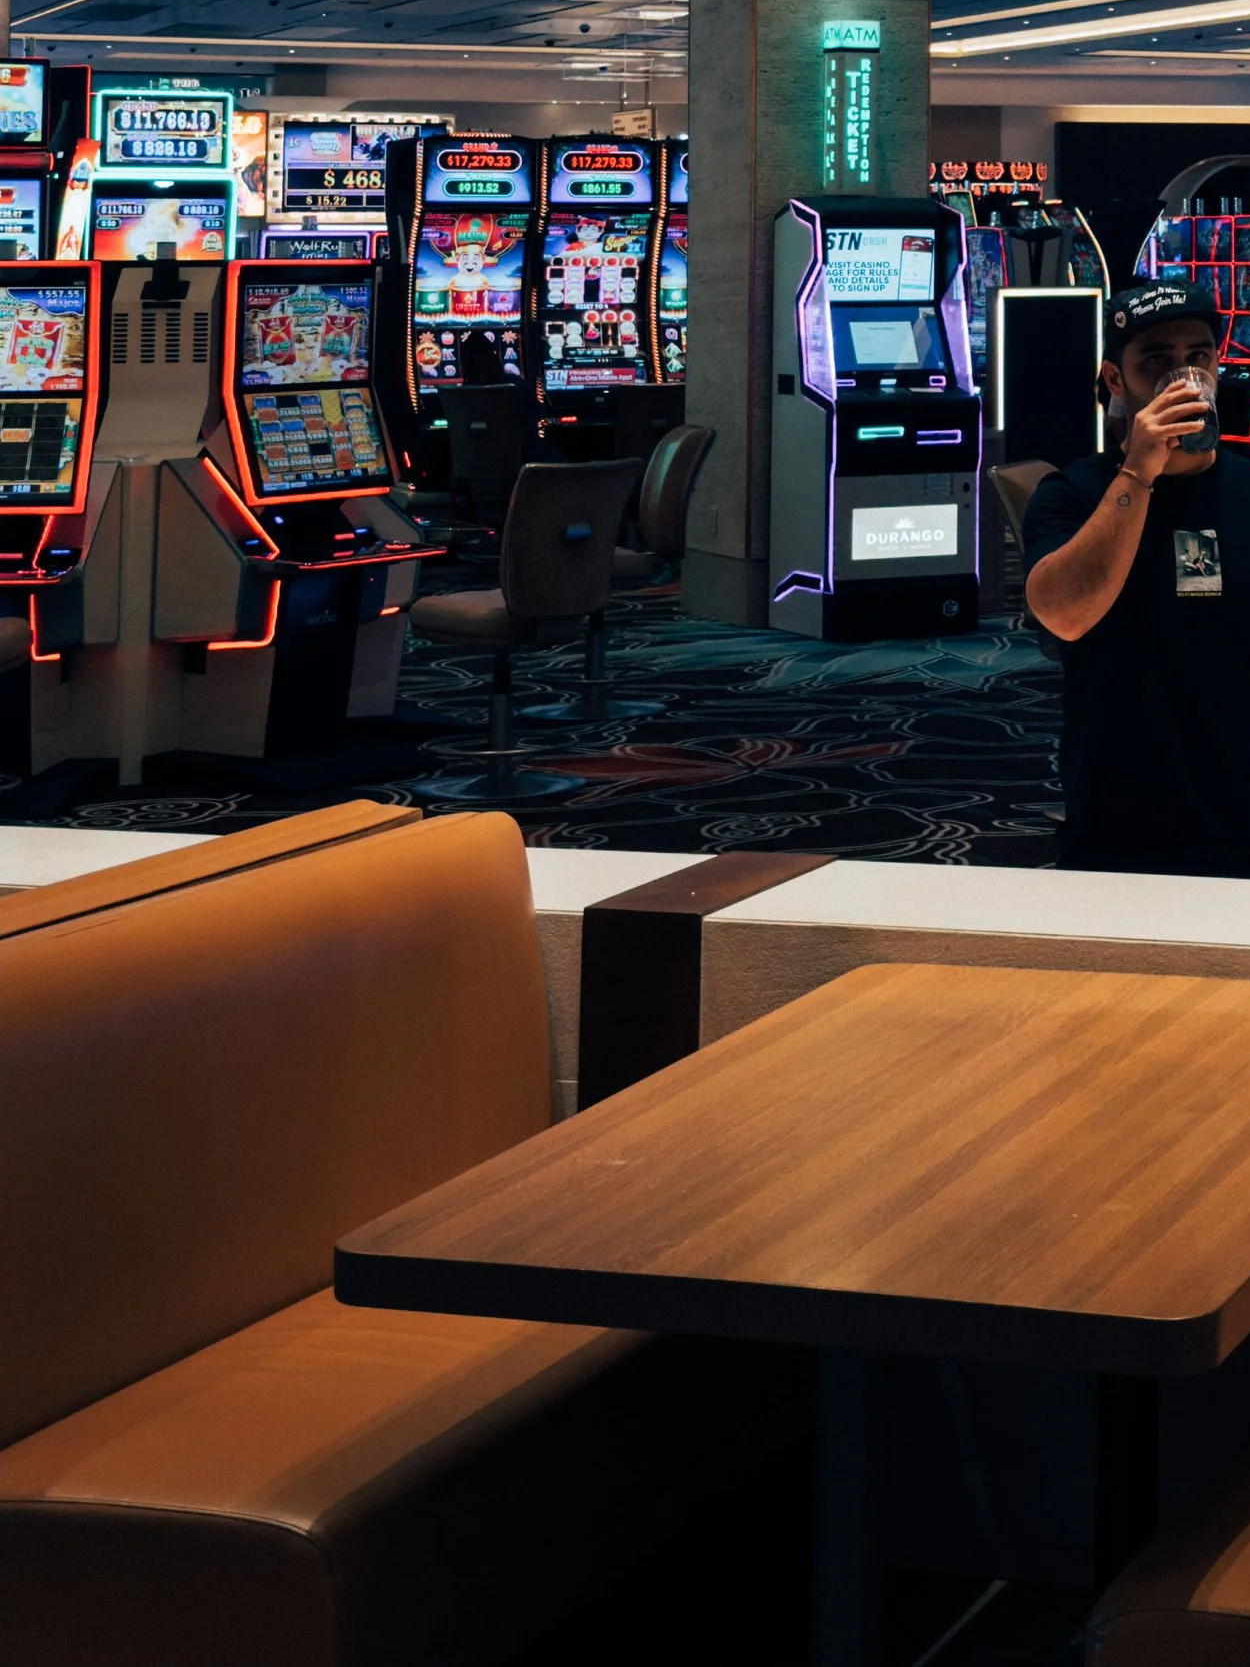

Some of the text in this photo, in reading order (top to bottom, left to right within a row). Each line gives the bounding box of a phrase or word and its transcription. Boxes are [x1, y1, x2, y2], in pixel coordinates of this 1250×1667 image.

[825, 27, 841, 41] ATM
[843, 27, 878, 42] ATM
[846, 58, 872, 182] TICKET REDEMPTION
[447, 155, 512, 168] $17,279.33
[571, 156, 633, 169] $17,279.33
[458, 183, 499, 193] $913.52
[582, 184, 622, 194] $861.55
[826, 232, 862, 250] STN
[833, 284, 845, 292] TO
[1154, 296, 1172, 311] Join
[1172, 294, 1187, 305] Us!
[546, 370, 568, 381] STN
[866, 529, 944, 545] DURANGO
